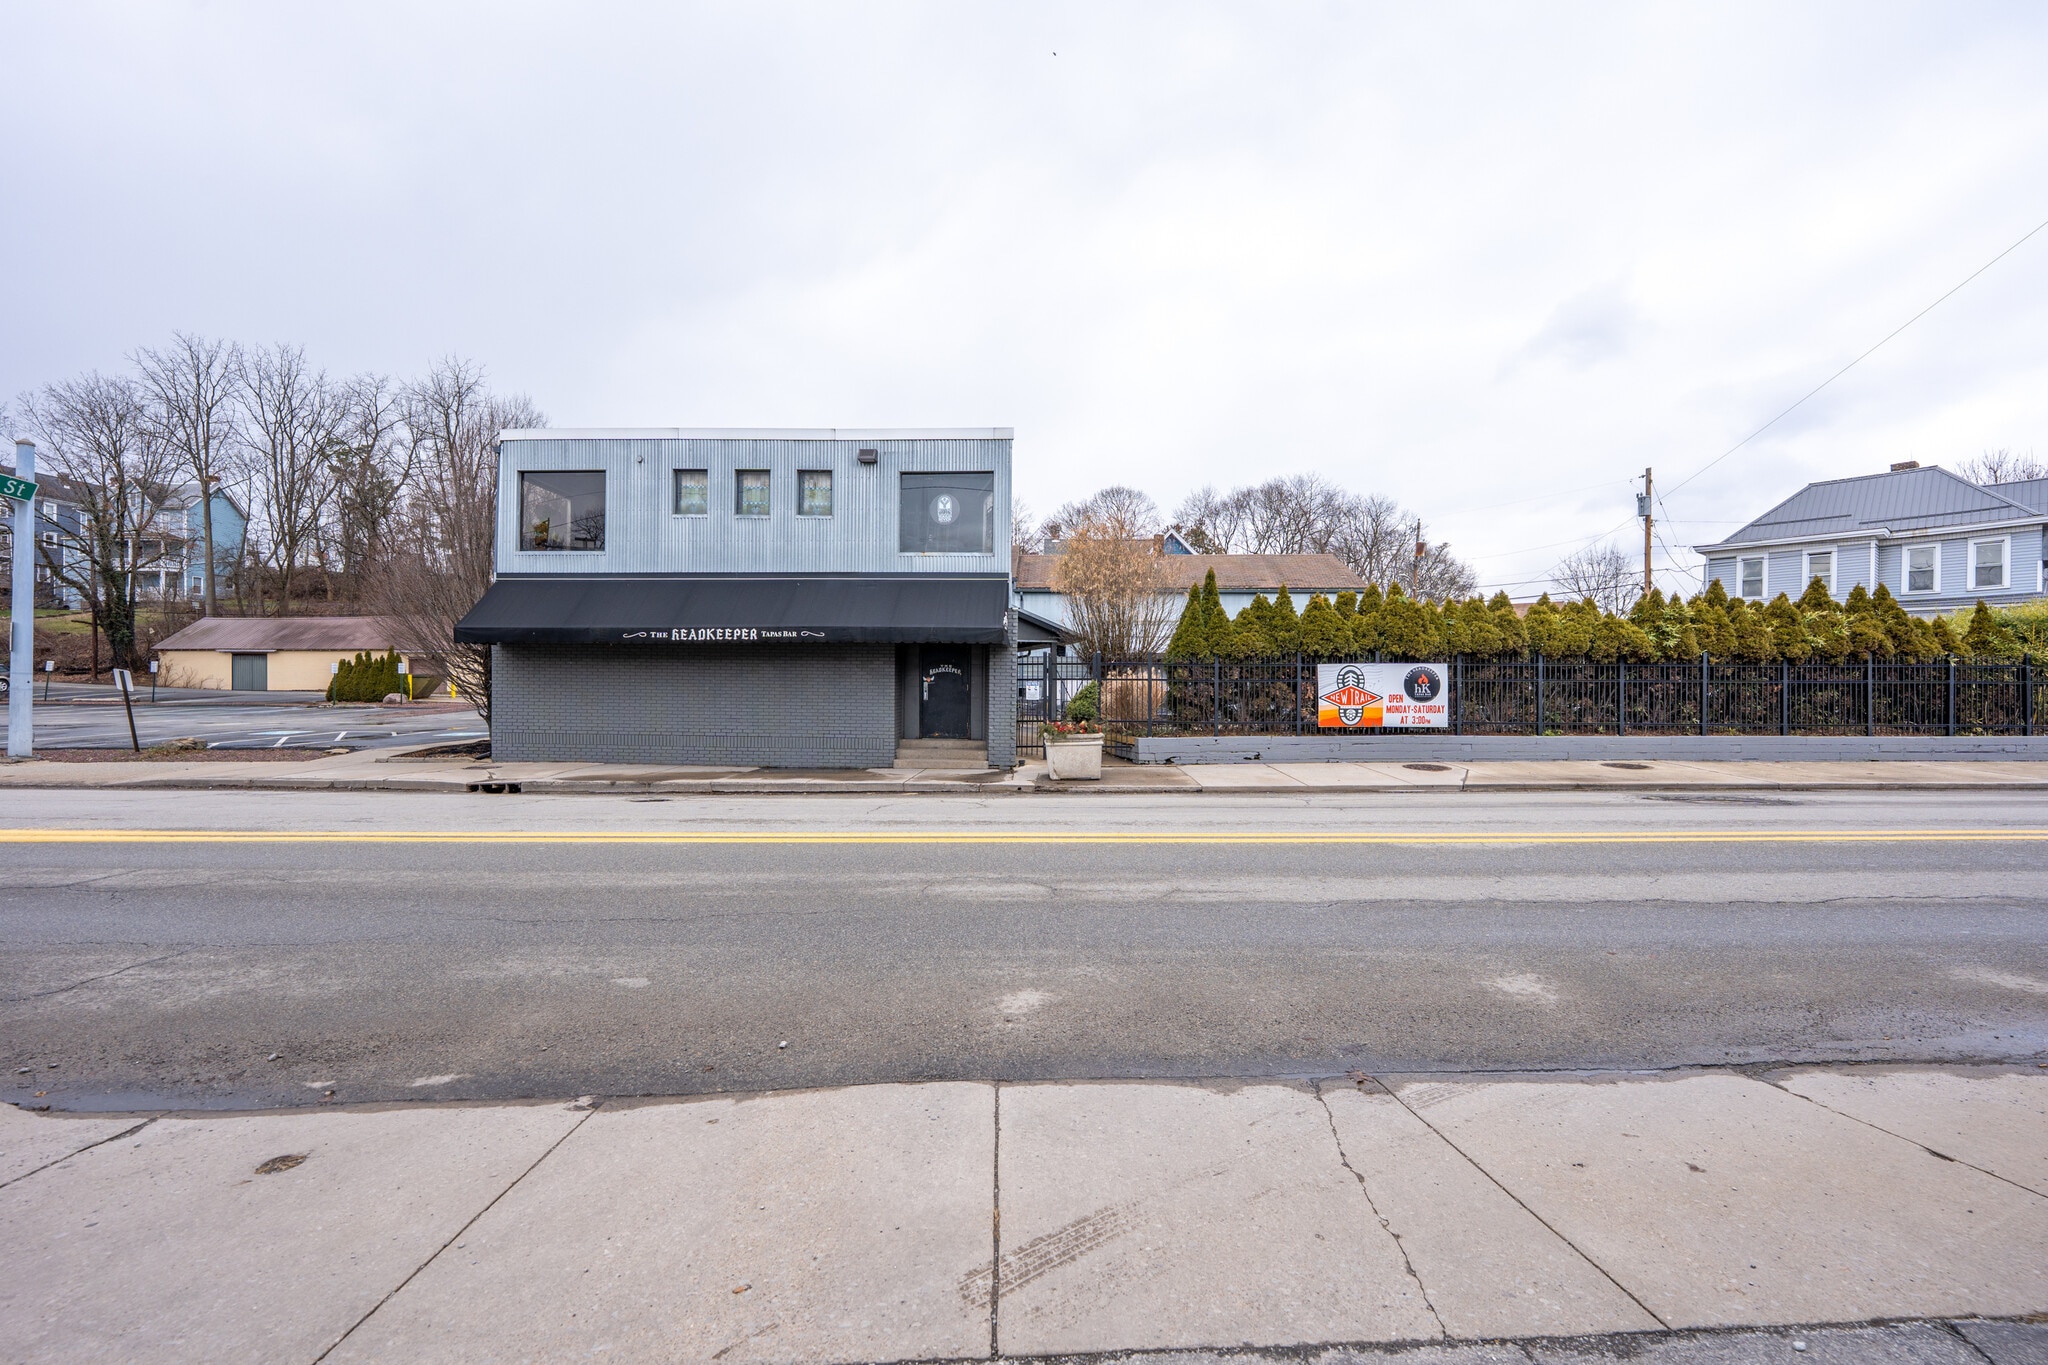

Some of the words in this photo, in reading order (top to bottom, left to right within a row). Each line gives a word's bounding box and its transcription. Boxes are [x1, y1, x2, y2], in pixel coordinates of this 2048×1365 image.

[3, 480, 26, 497] St
[671, 628, 758, 640] HEADKEEPER
[761, 630, 782, 638] TAPAS
[1330, 690, 1349, 704] NEW
[1350, 688, 1373, 705] TRAIL
[1388, 694, 1404, 703] OPEN
[1400, 715, 1409, 724] AT
